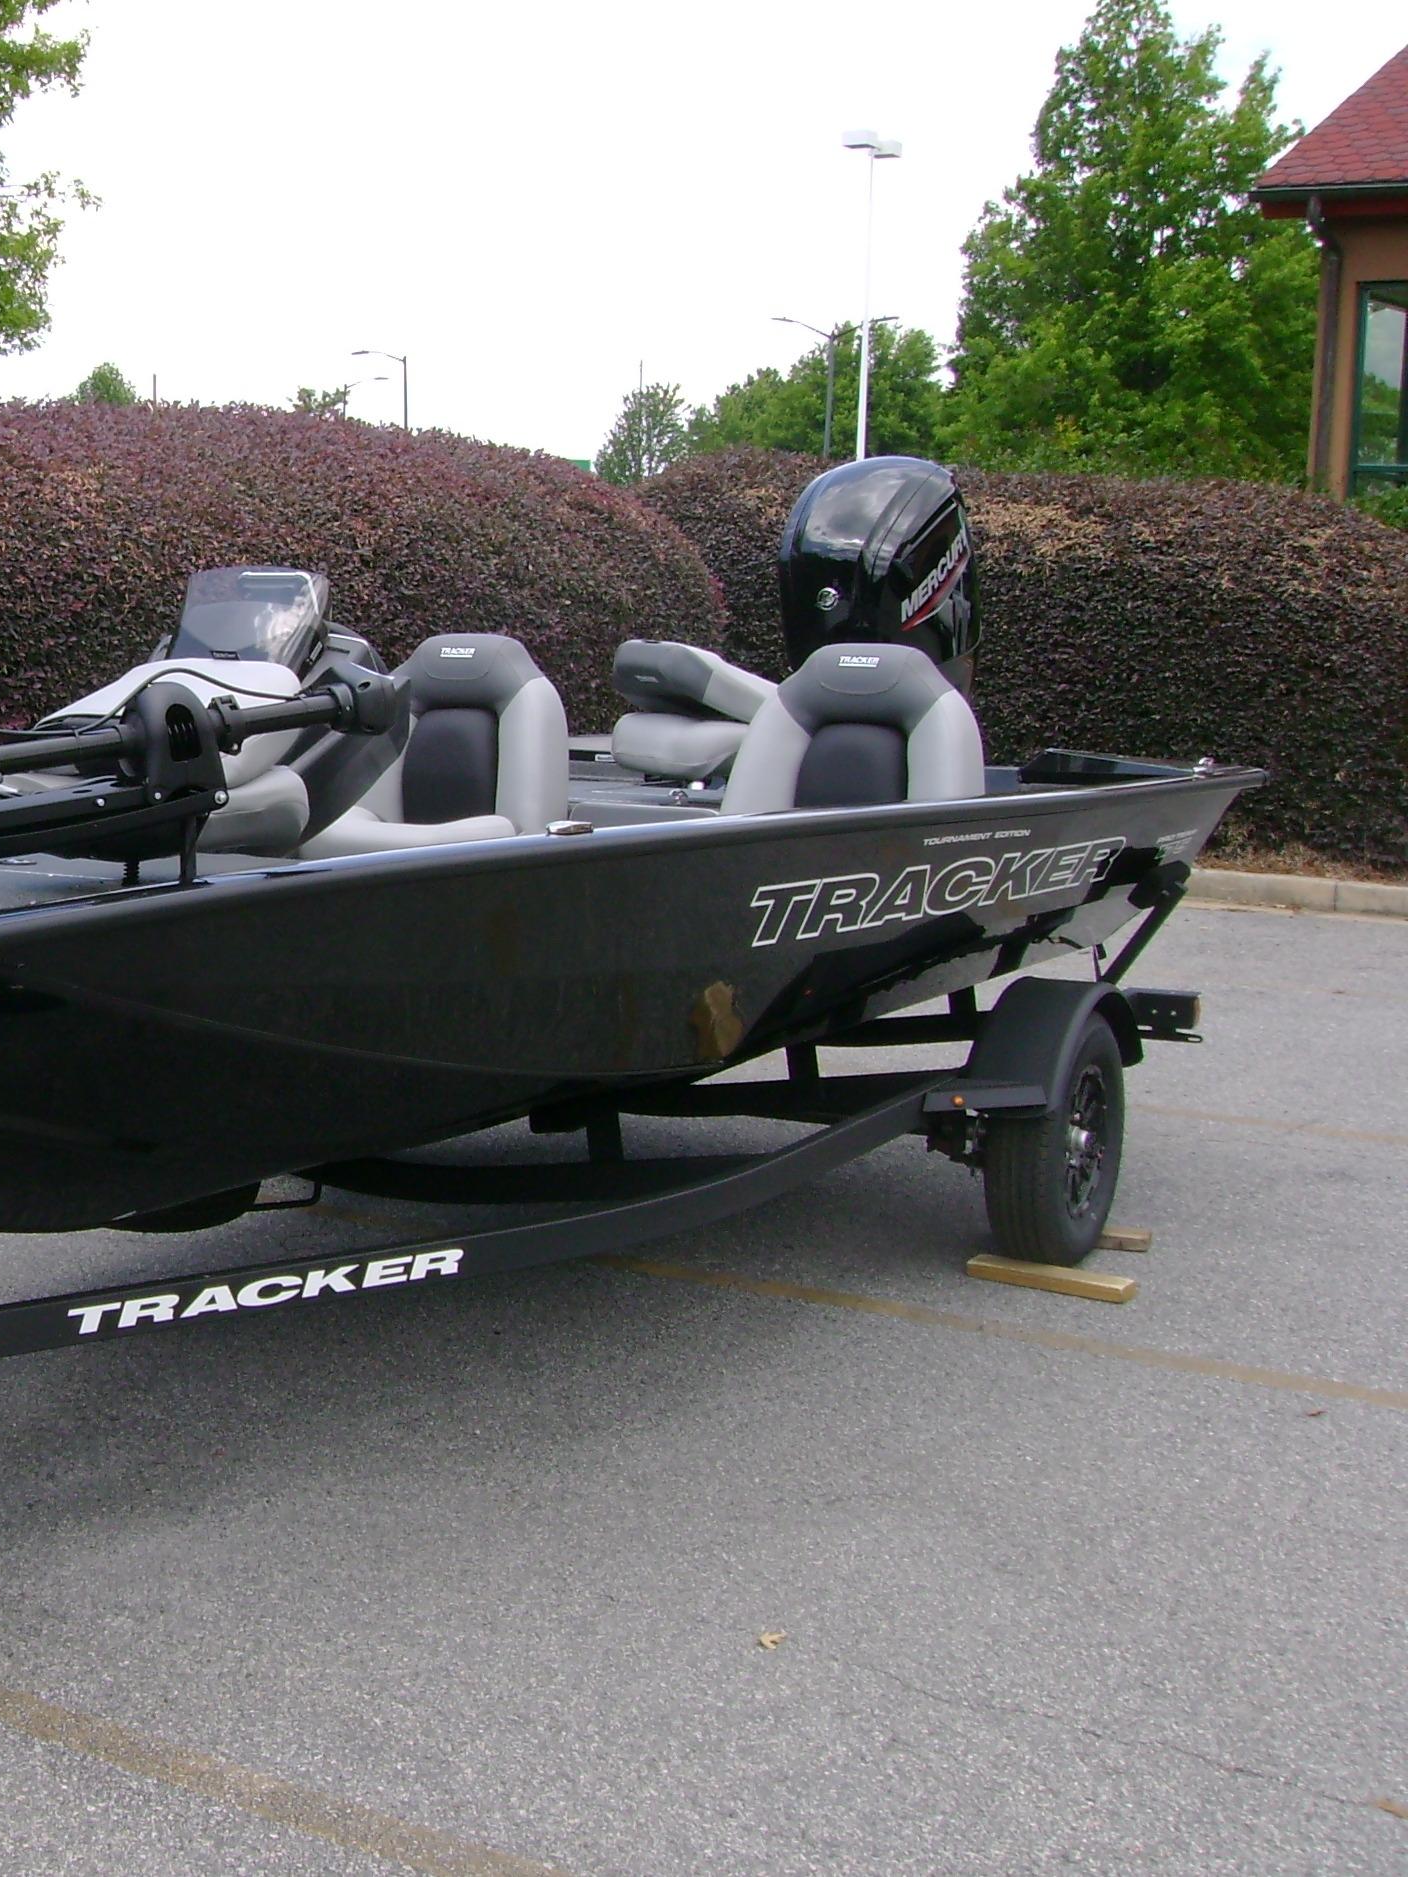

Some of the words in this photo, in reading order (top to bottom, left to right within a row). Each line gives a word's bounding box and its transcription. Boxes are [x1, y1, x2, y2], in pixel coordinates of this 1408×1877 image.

[839, 655, 880, 664] TRACKER
[923, 831, 993, 846] TOURNAMENT
[994, 829, 1032, 839] EDITION
[750, 836, 1127, 948] TRACKER
[67, 1248, 465, 1335] TRACKER
